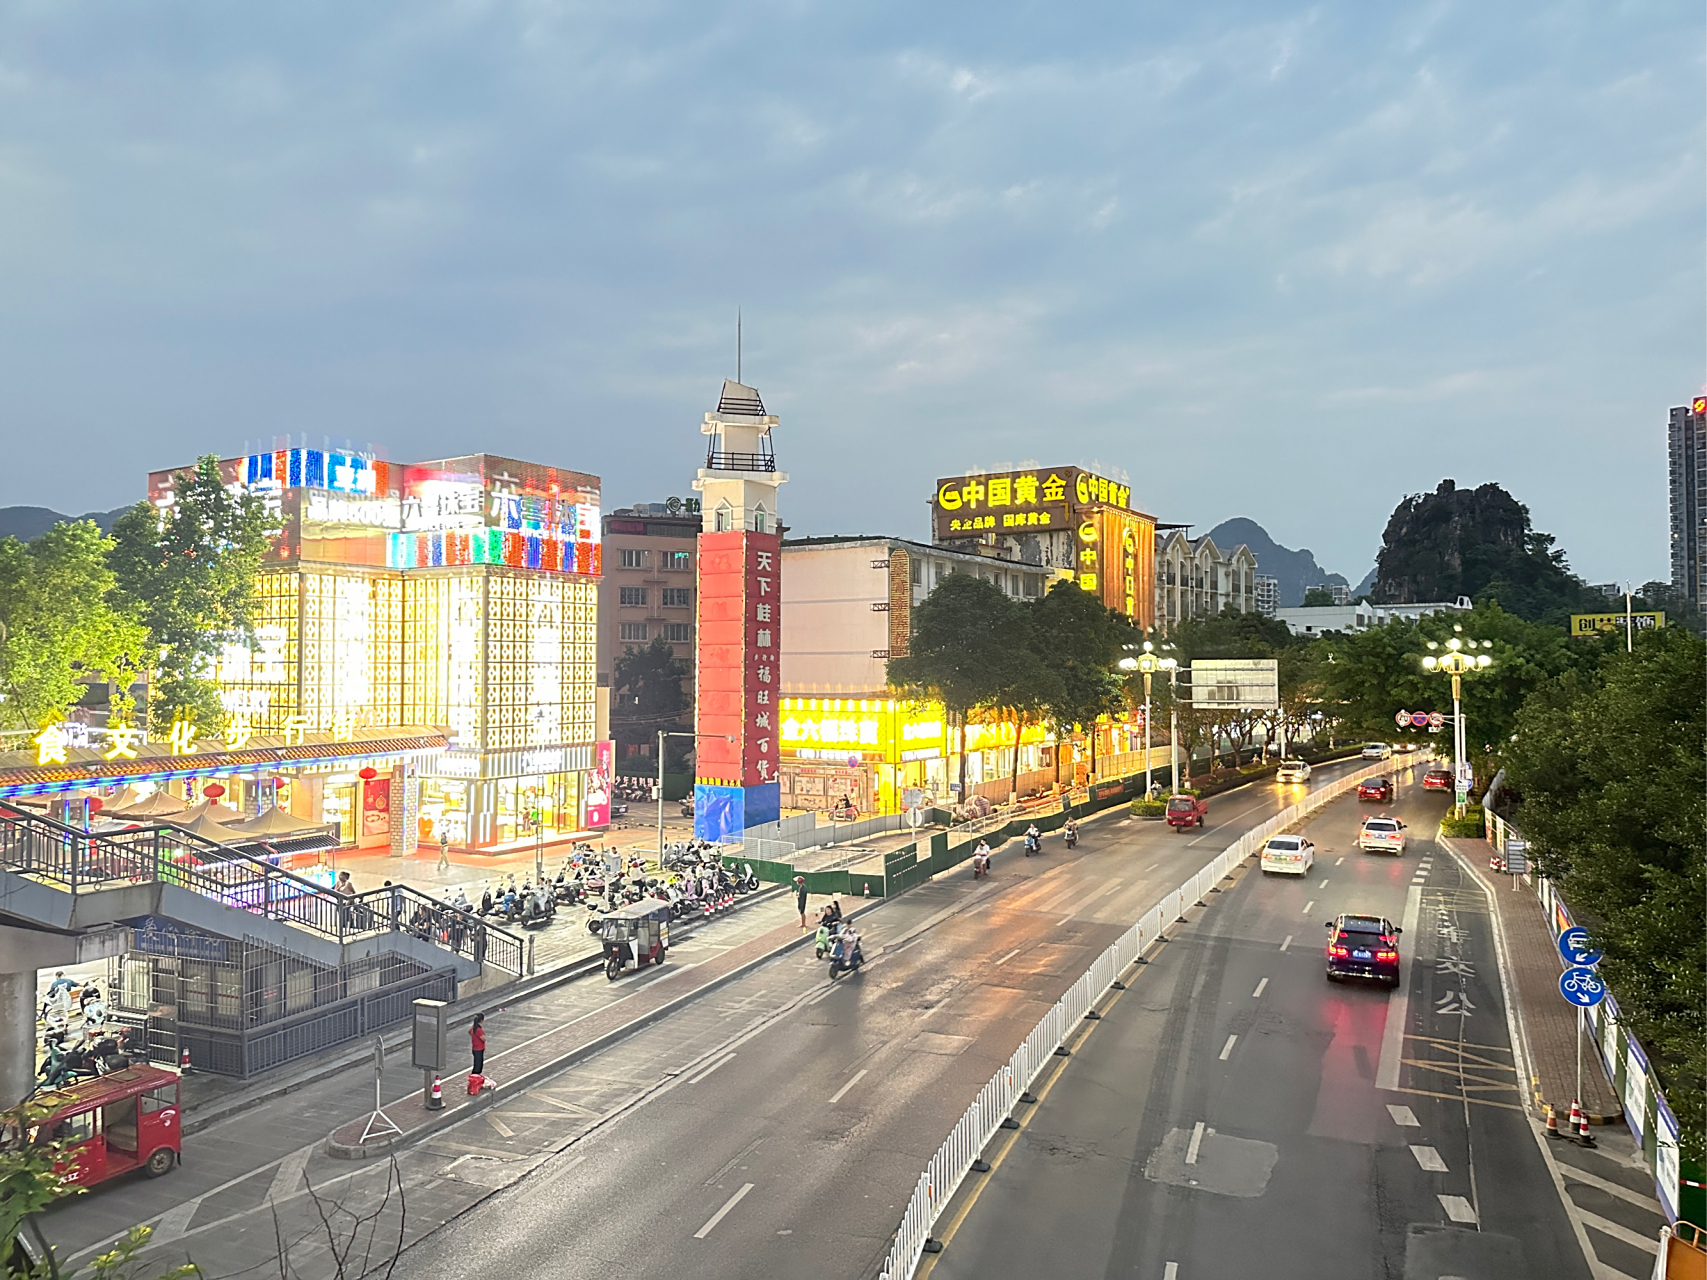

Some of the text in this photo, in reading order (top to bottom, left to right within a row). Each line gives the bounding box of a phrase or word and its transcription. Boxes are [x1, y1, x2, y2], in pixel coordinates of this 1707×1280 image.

[963, 474, 1066, 509] 中国黄金
[1089, 475, 1128, 508] 中国黄金
[950, 511, 1051, 532] 央企品牌 国库黄金
[1080, 548, 1097, 590] 中国
[757, 551, 772, 648] 天下桂林
[755, 665, 772, 780] 福旺城百货
